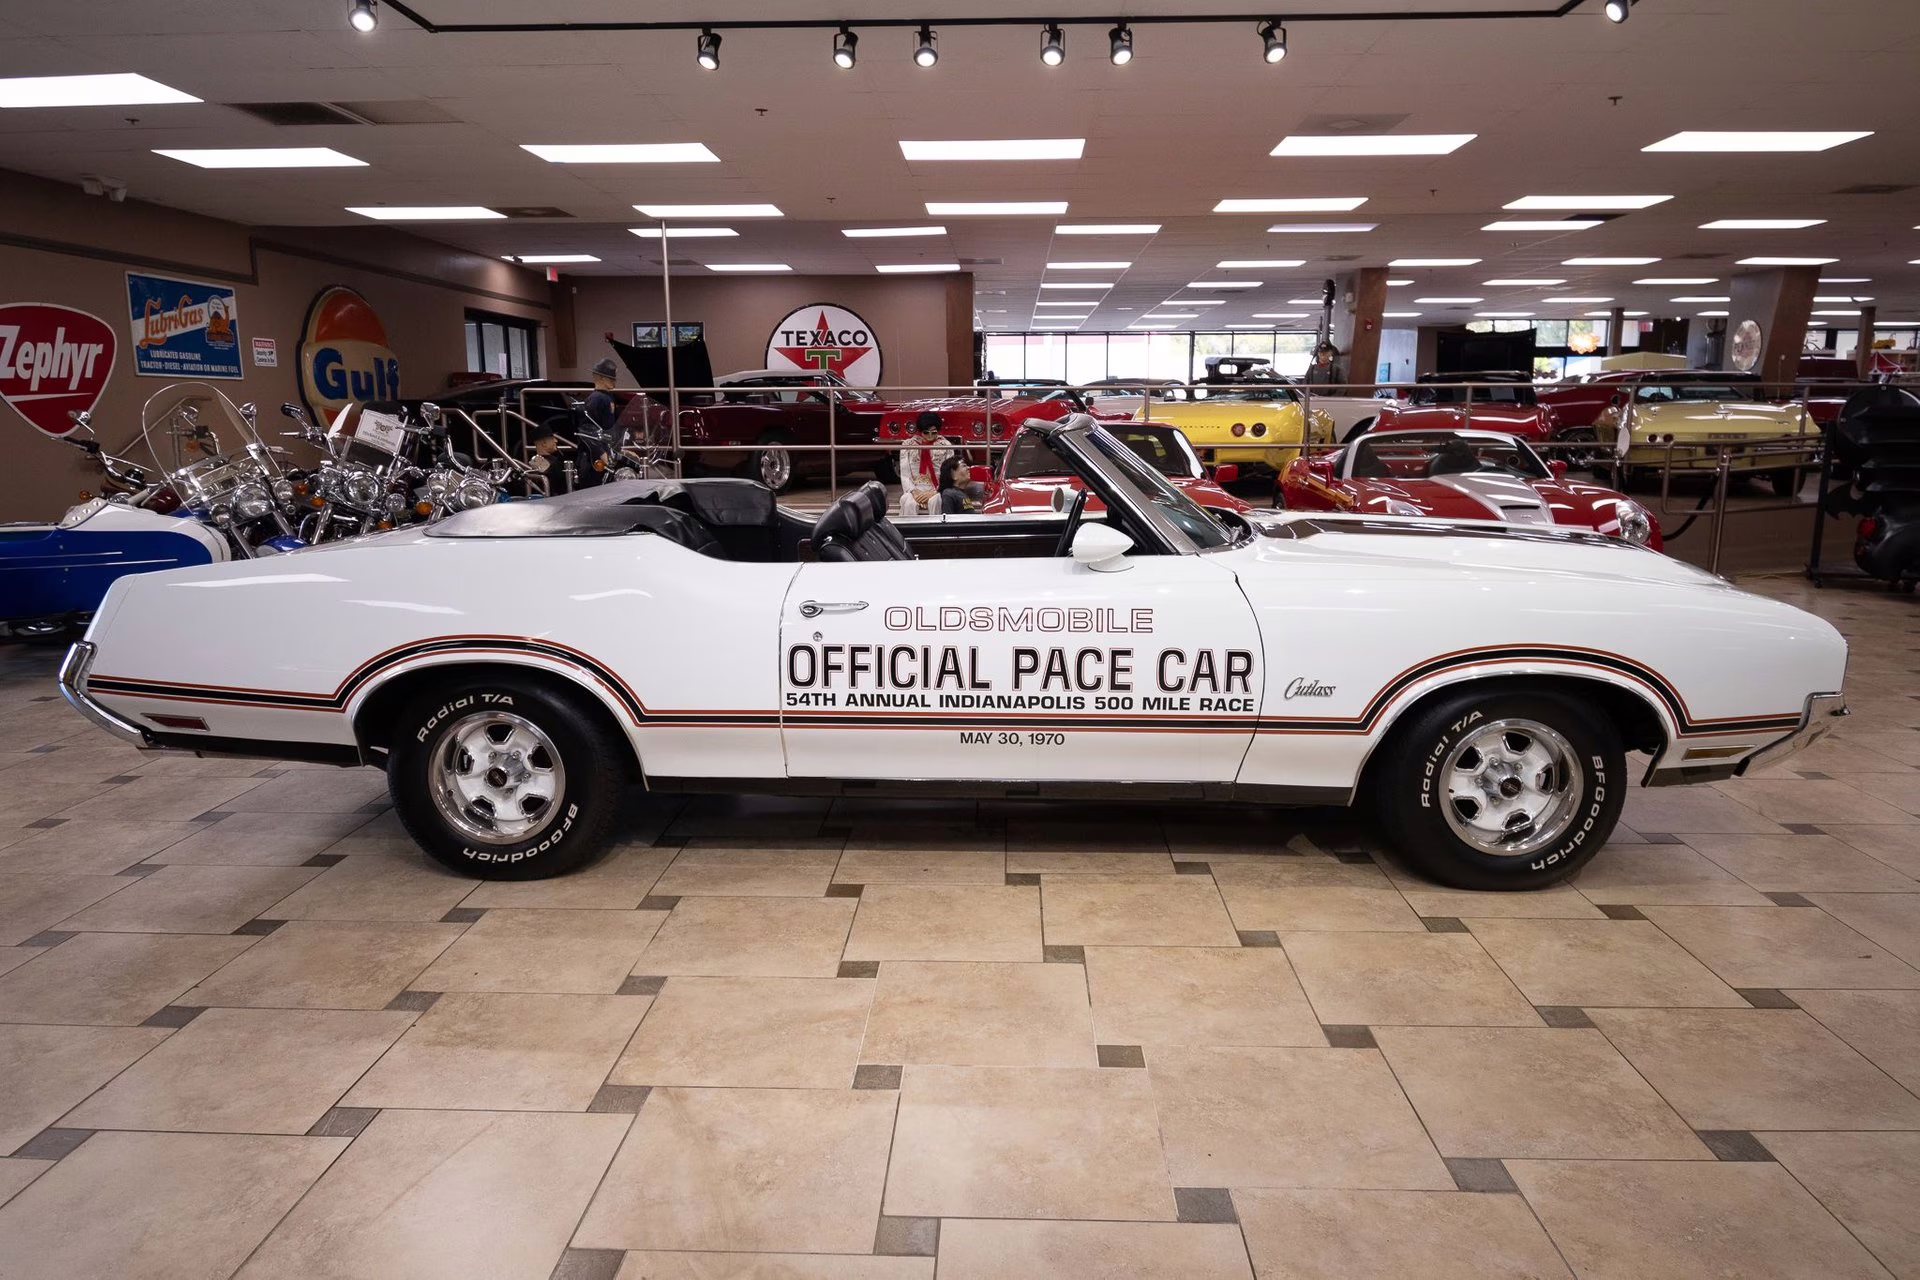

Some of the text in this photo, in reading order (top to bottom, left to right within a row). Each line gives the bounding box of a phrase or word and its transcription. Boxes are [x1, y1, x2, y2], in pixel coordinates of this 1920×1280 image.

[781, 330, 868, 346] TEXACO
[0, 324, 104, 391] Zephyr
[140, 361, 240, 374] TRACTOR DIESEL AVIATION OR MARINE FUEL
[150, 350, 202, 361] LUBRICATED GASOLINE
[805, 349, 842, 370] T
[313, 347, 399, 401] Gulf
[884, 606, 1154, 633] OLDSMOBILE
[787, 643, 1255, 695] OFFICIAL PACE CAR
[1284, 676, 1337, 700] Cutlass
[786, 692, 1254, 713] 54TH ANNUAL INDIANAPOLIS 500 MILE RACE
[416, 693, 515, 743] Radial T/A
[959, 732, 1066, 747] MAY 30, 1970
[1421, 710, 1484, 808] Radial T/A
[1531, 755, 1606, 872] BFGoodrich
[462, 803, 579, 864] BFGoodrich
